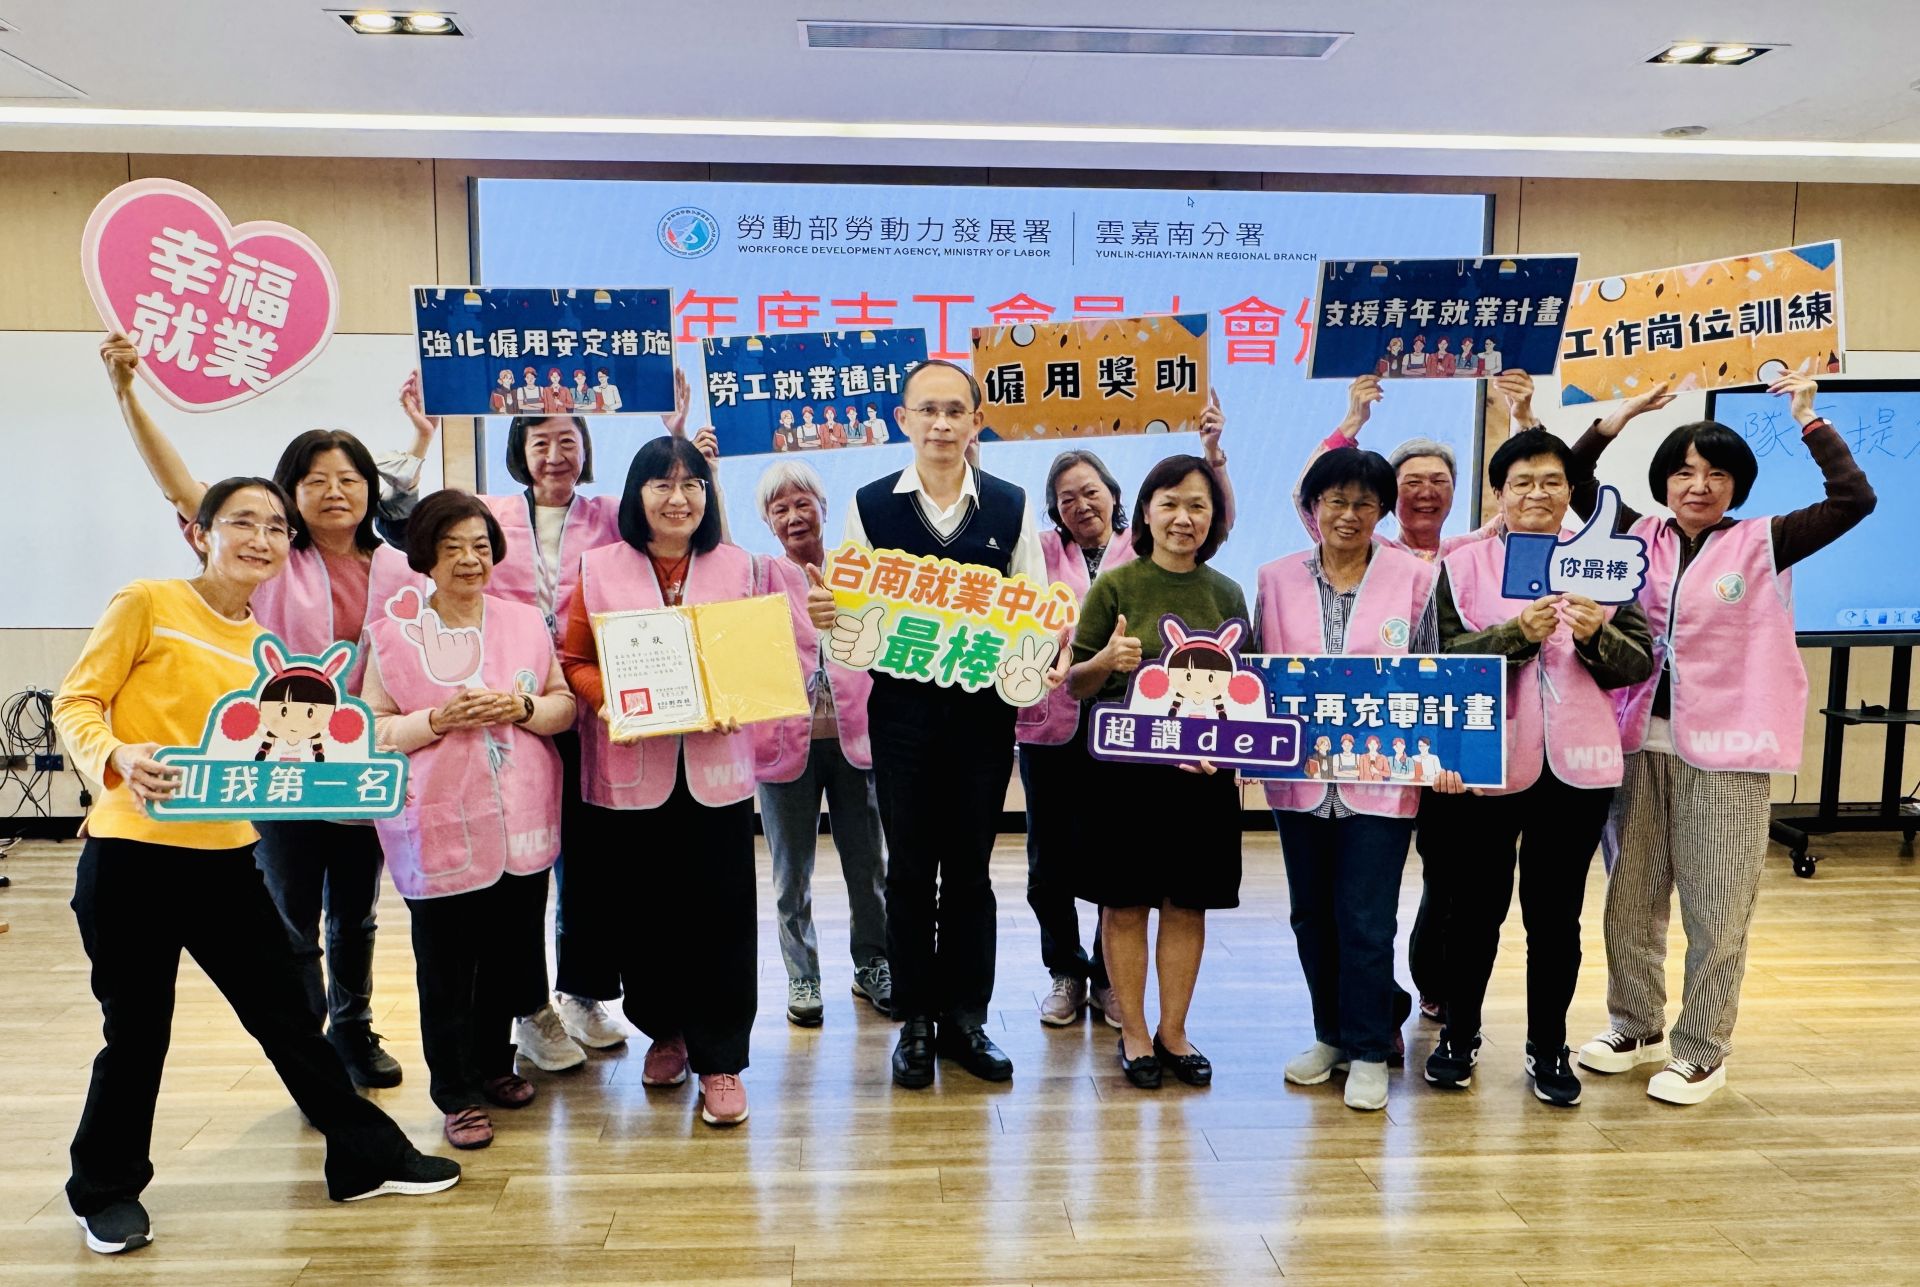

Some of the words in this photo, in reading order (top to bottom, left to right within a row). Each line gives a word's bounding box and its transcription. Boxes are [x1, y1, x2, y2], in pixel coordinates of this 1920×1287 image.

[737, 214, 1051, 244] 勞動部勞動力發展署
[1096, 220, 1265, 247] 雲嘉南分署
[738, 245, 809, 254] WORKFORCE
[812, 246, 892, 255] DEVELOPMENT
[894, 247, 941, 257] AGENCY,
[944, 248, 993, 257] MINISTRY
[996, 249, 1011, 257] OF
[1014, 249, 1051, 257] LABOR
[1095, 250, 1213, 260] YUNLIN-CHIAYI-TAINAN
[1217, 252, 1271, 261] REGIONAL
[1274, 253, 1317, 261] BRANCH
[149, 226, 297, 329] 幸福
[1325, 296, 1564, 328] 支援青年就業計畫
[1563, 291, 1833, 360] 工作崗位訓練
[127, 291, 279, 394] 就業
[422, 329, 672, 358] 強化僱用安定措施
[709, 361, 920, 407] 勞工就業通計
[985, 355, 1198, 406] 僱用獎助
[1560, 557, 1628, 581] 你最棒
[830, 547, 1075, 632] 台南就業中心
[878, 616, 1005, 688] 最棒
[1271, 692, 1496, 731] 工再充電計畫
[1690, 730, 1781, 753] WDA
[172, 764, 390, 803] 叫我第一名
